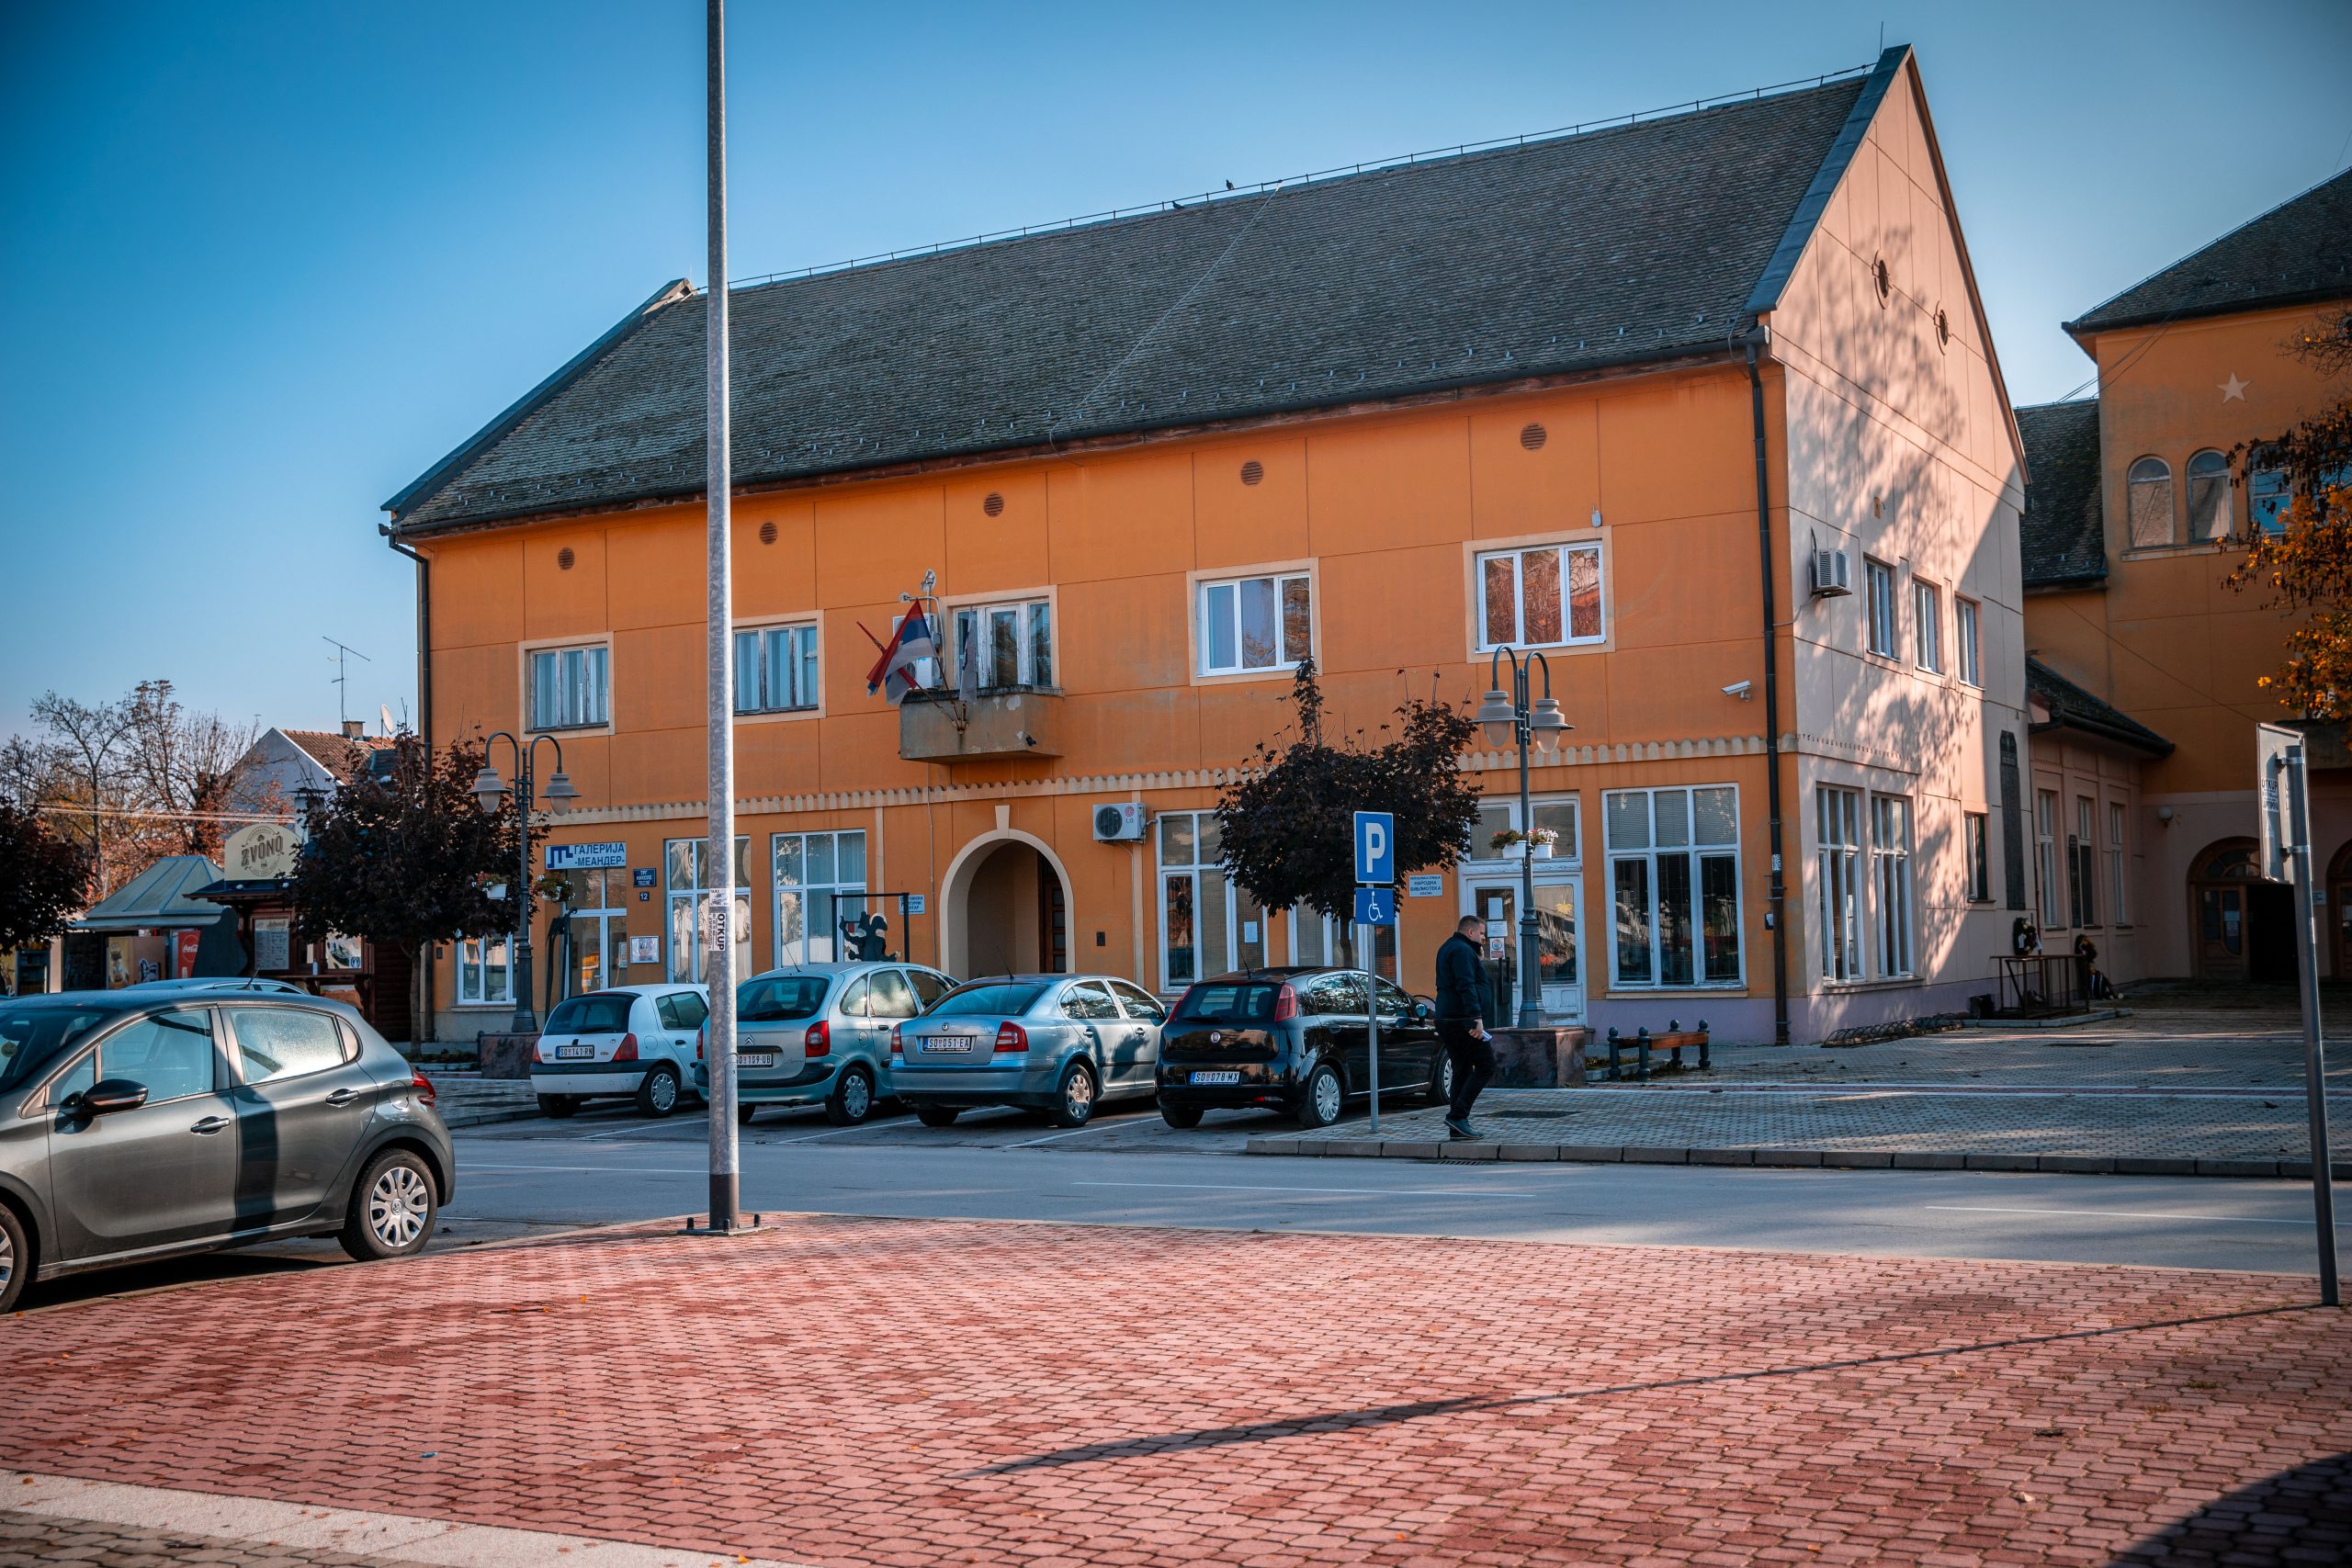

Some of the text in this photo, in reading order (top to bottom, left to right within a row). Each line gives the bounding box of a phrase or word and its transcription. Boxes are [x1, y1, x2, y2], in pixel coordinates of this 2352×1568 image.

[241, 835, 284, 867] ZVONO
[574, 843, 625, 855] ГАЛЕРИЈА
[1365, 822, 1385, 874] P
[574, 855, 625, 867] -МЕАНДЕР-
[639, 892, 649, 900] 12
[717, 913, 726, 951] OTKUP
